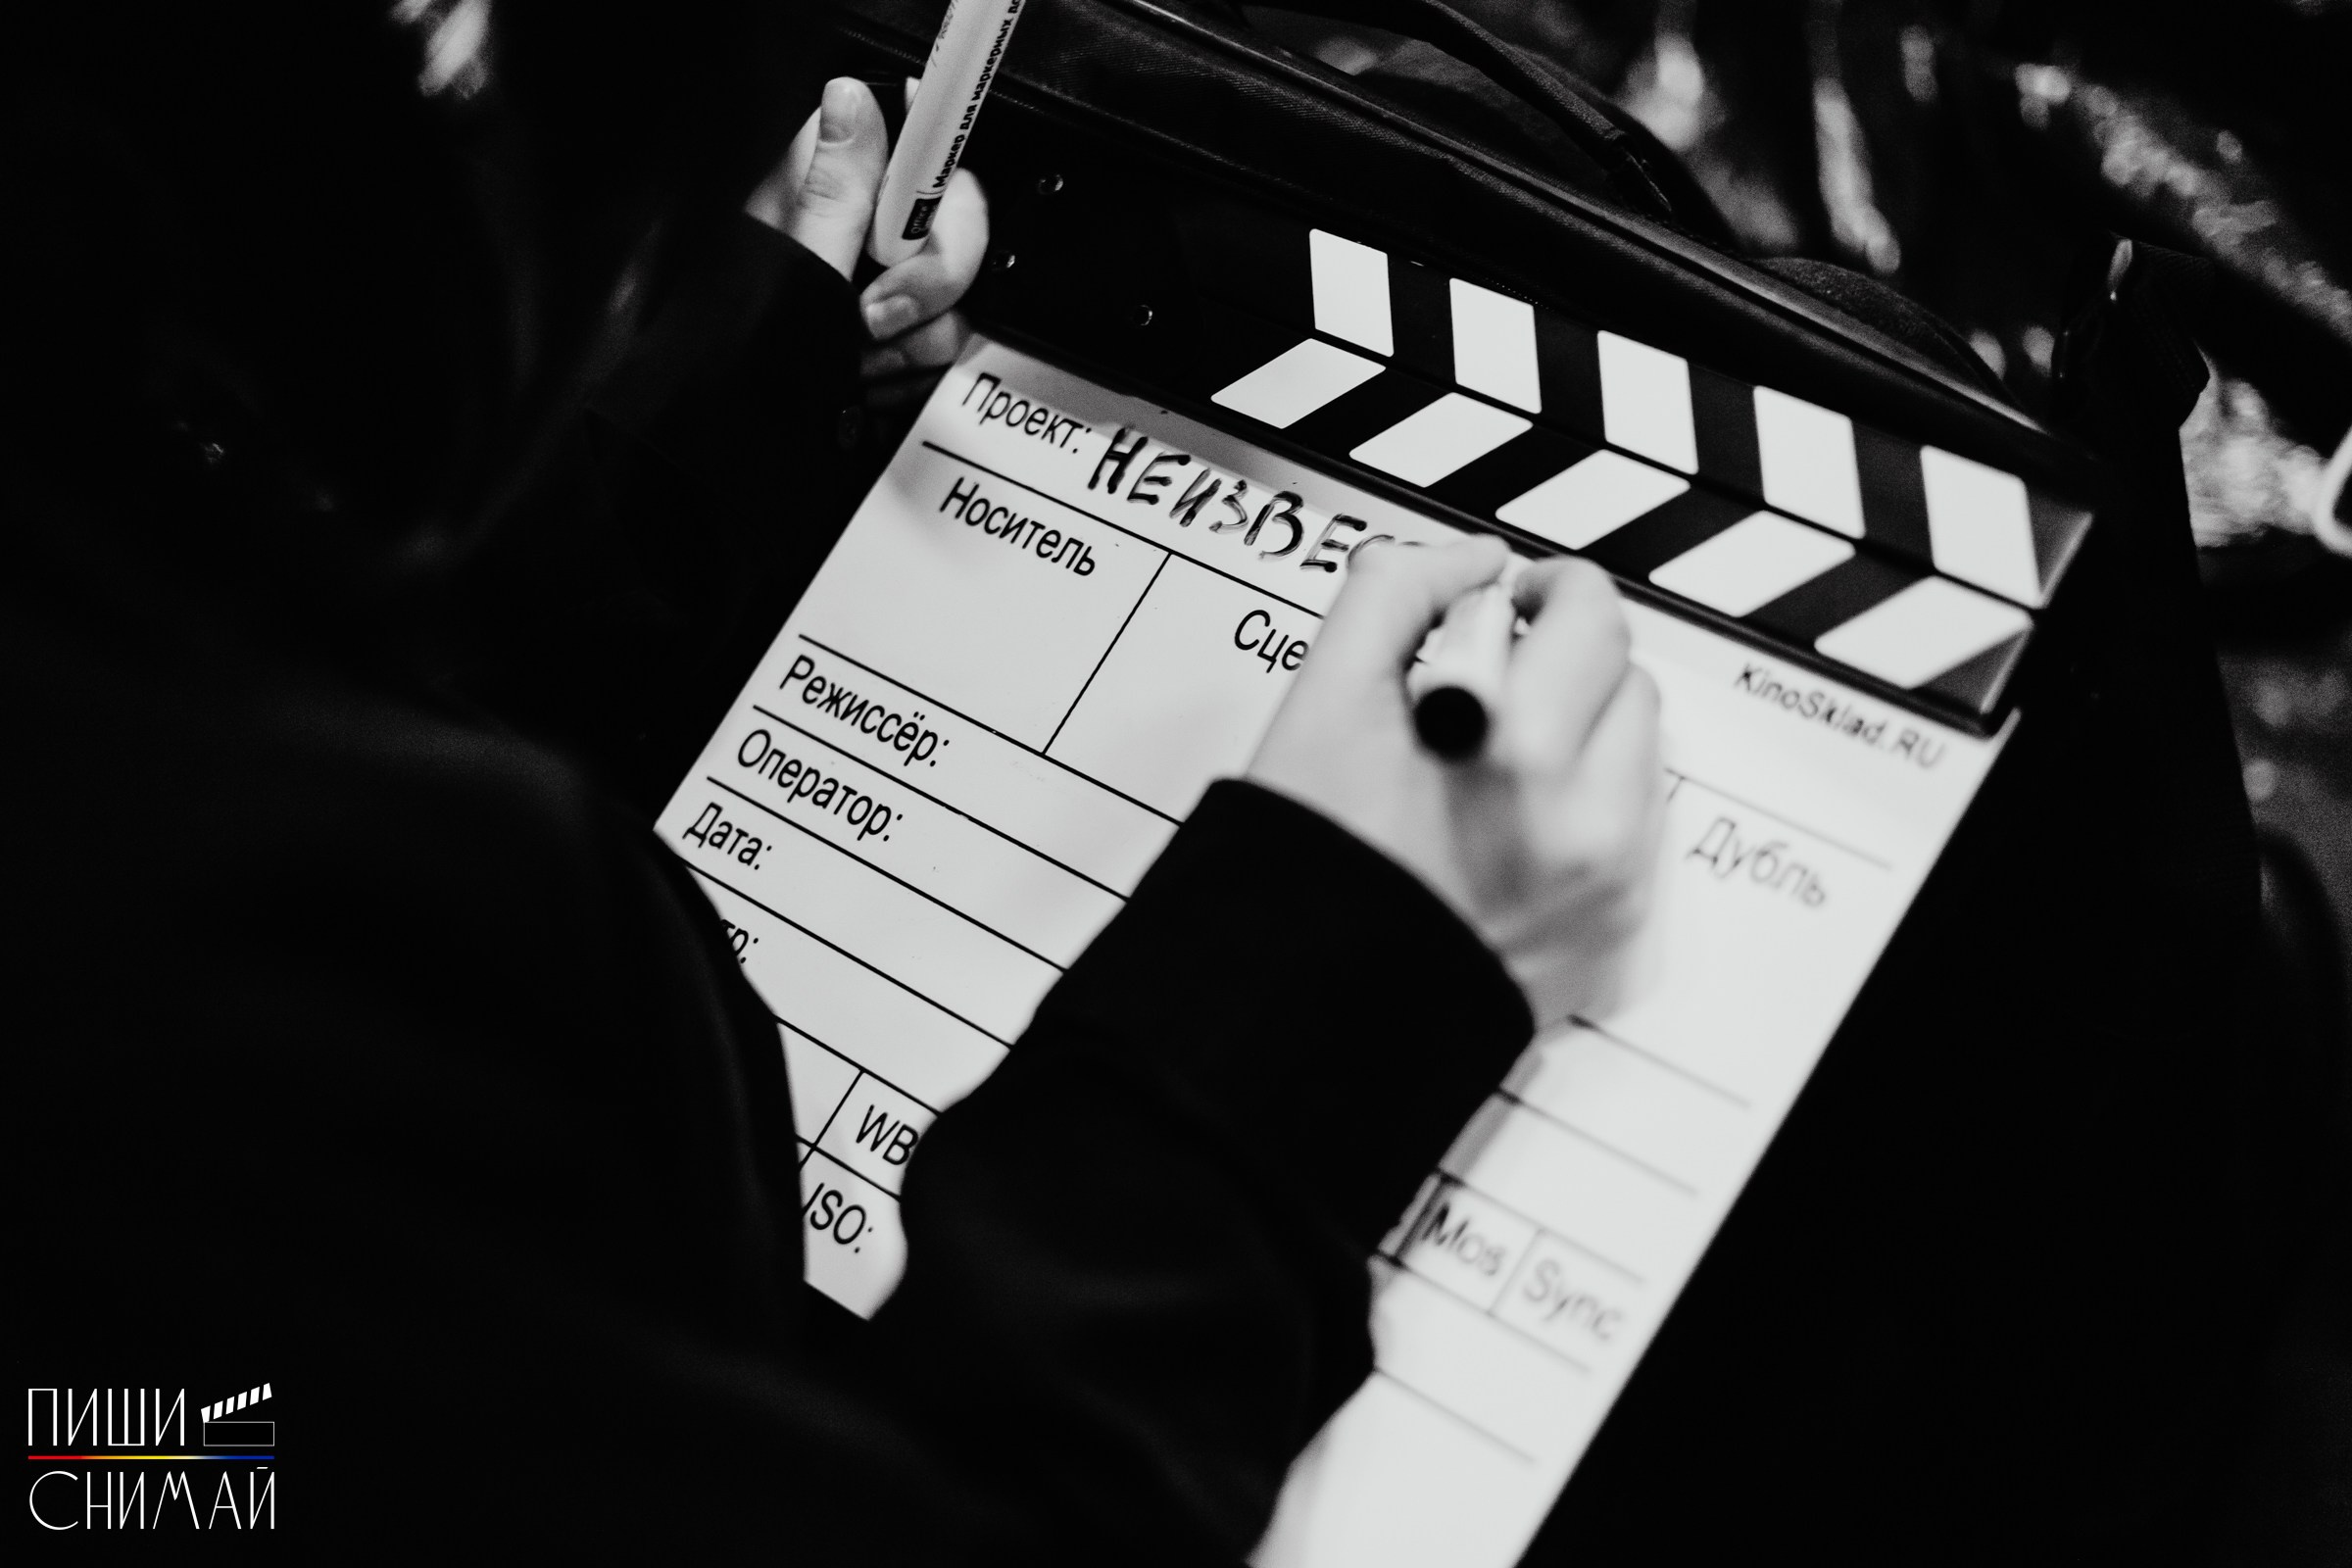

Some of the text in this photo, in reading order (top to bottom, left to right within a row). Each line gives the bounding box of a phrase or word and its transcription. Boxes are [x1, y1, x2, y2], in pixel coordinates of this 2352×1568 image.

[932, 134, 965, 188] Маркер
[959, 104, 978, 130] для
[970, 18, 1012, 102] маркерных
[961, 371, 1093, 454] Проект:
[938, 476, 1098, 577] Носитель
[778, 653, 952, 767] Режиссёр:
[736, 728, 904, 842] Оператор:
[682, 801, 773, 871] Дата:
[1684, 815, 1828, 908] Дубль
[803, 1182, 874, 1254] ISO:
[1522, 1257, 1623, 1342] Sync
